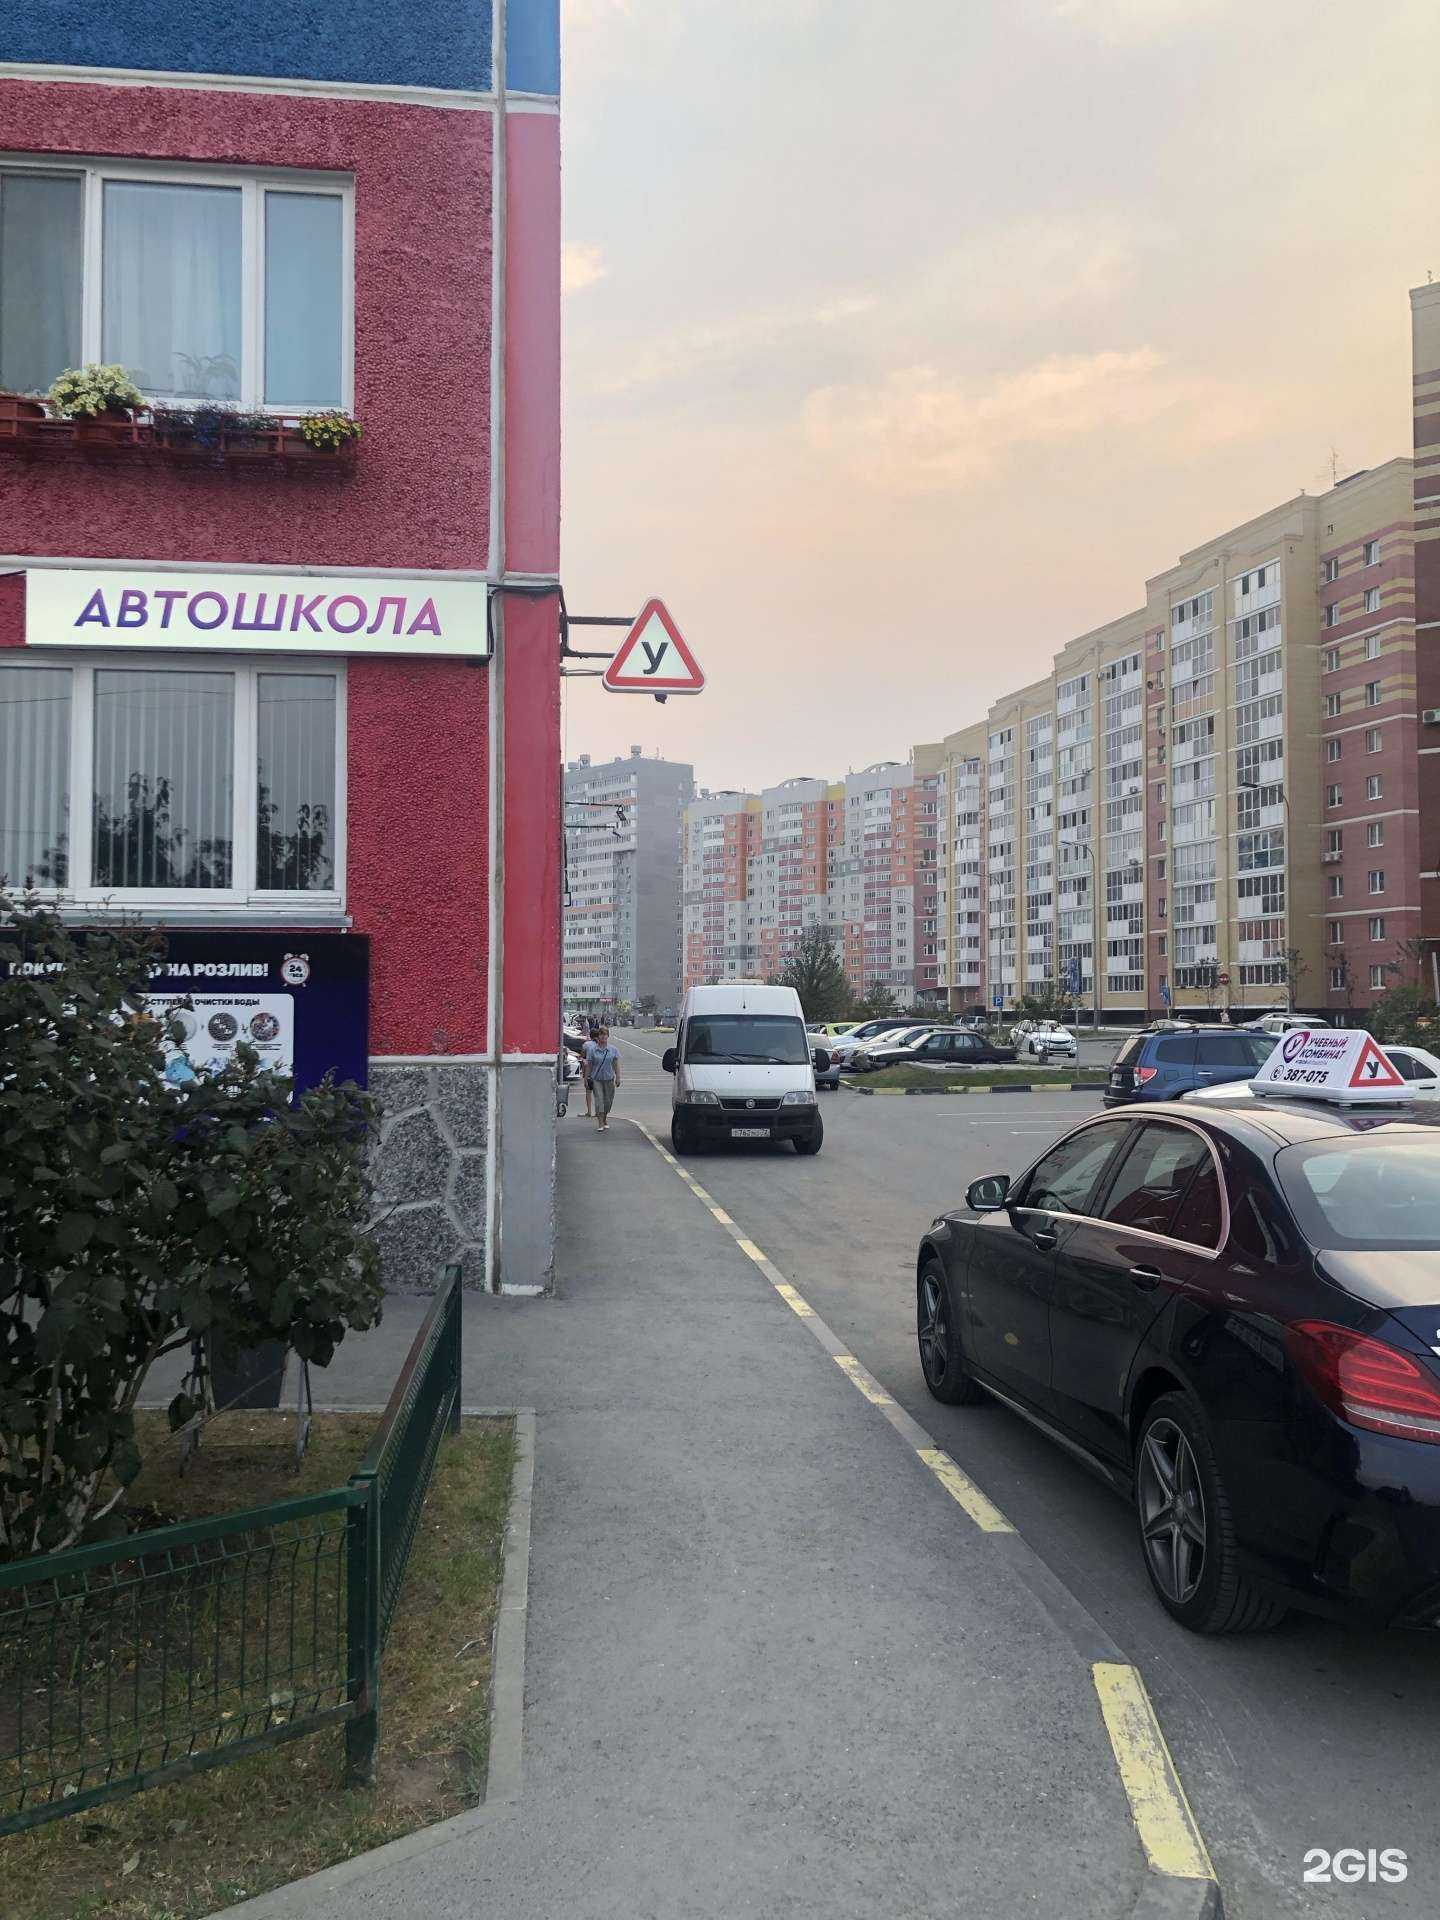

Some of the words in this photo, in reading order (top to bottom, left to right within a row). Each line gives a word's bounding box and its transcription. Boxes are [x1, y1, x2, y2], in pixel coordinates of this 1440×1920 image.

[74, 588, 443, 637] АВТОШКОЛА
[193, 963, 269, 977] РОЗЛИВ!
[1308, 1036, 1350, 1048] УЧЕБНЫЙ
[1299, 1048, 1347, 1060] КОМБИНАТ
[1283, 1068, 1330, 1083] 387-075
